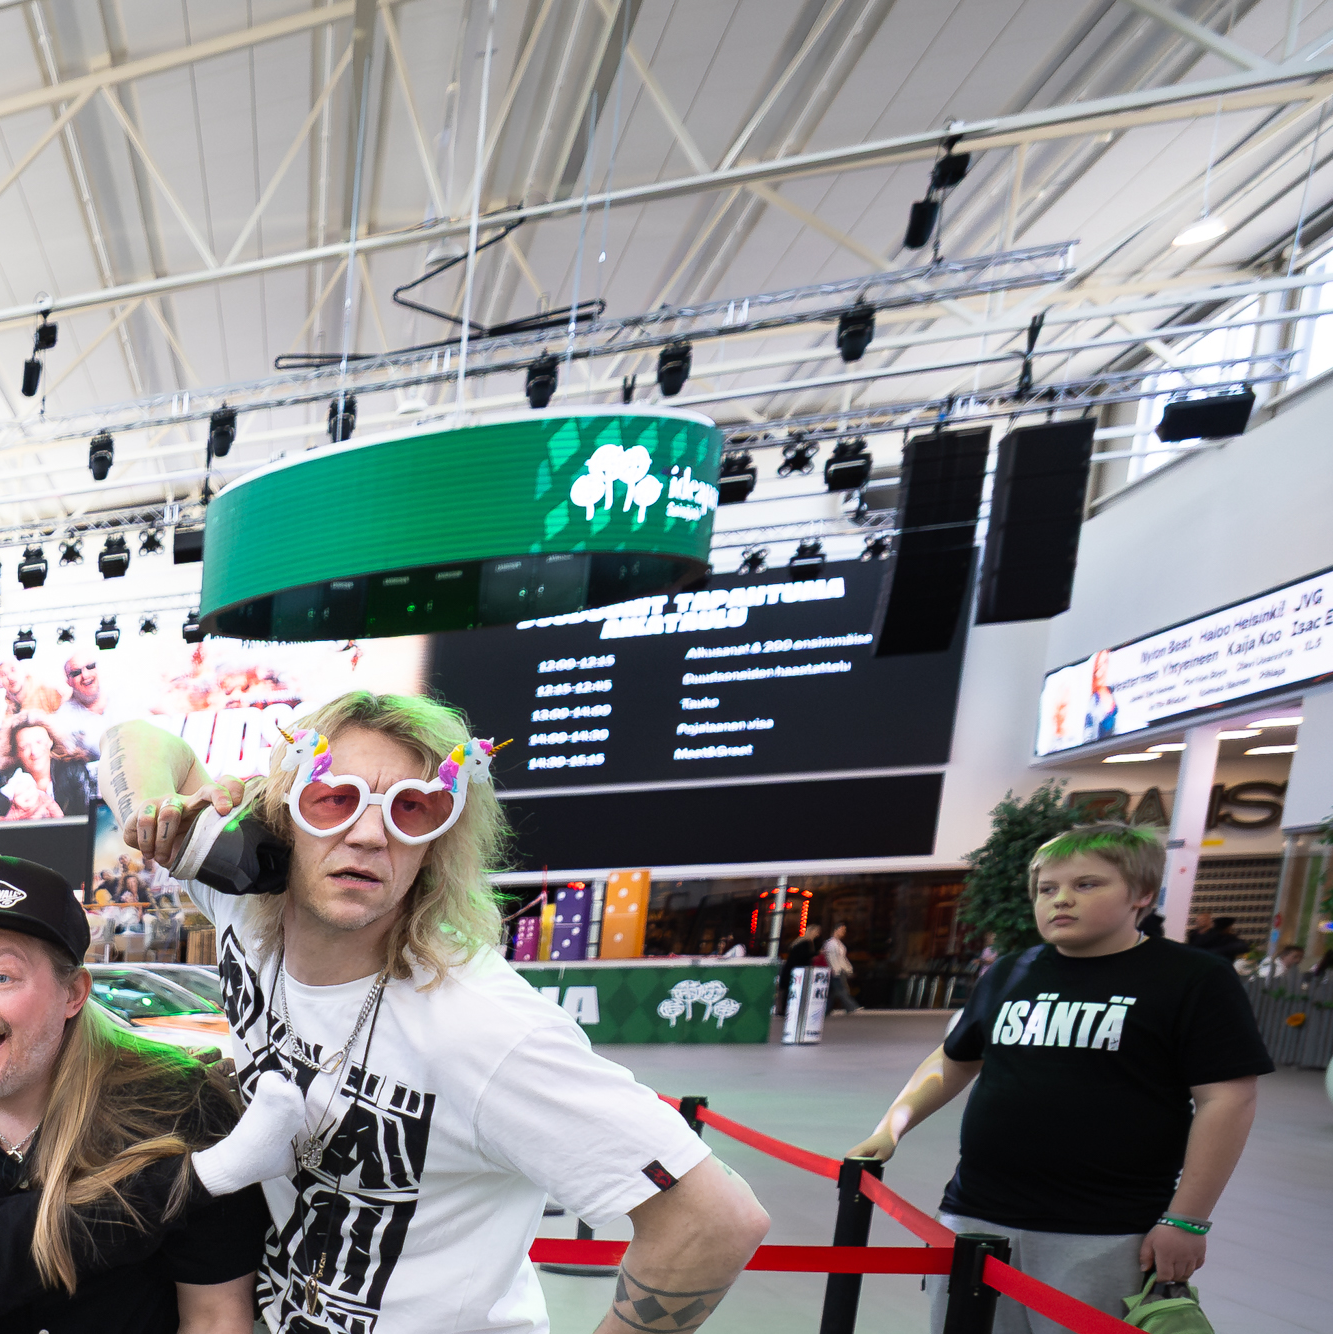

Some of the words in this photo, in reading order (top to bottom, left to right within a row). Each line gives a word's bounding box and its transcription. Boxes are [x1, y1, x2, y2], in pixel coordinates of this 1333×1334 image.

[1293, 587, 1324, 612] JVG
[1227, 634, 1256, 658] Kaija
[1258, 629, 1283, 647] Koo
[1291, 614, 1322, 637] Isac
[991, 992, 1137, 1051] ISÄNTÄ
